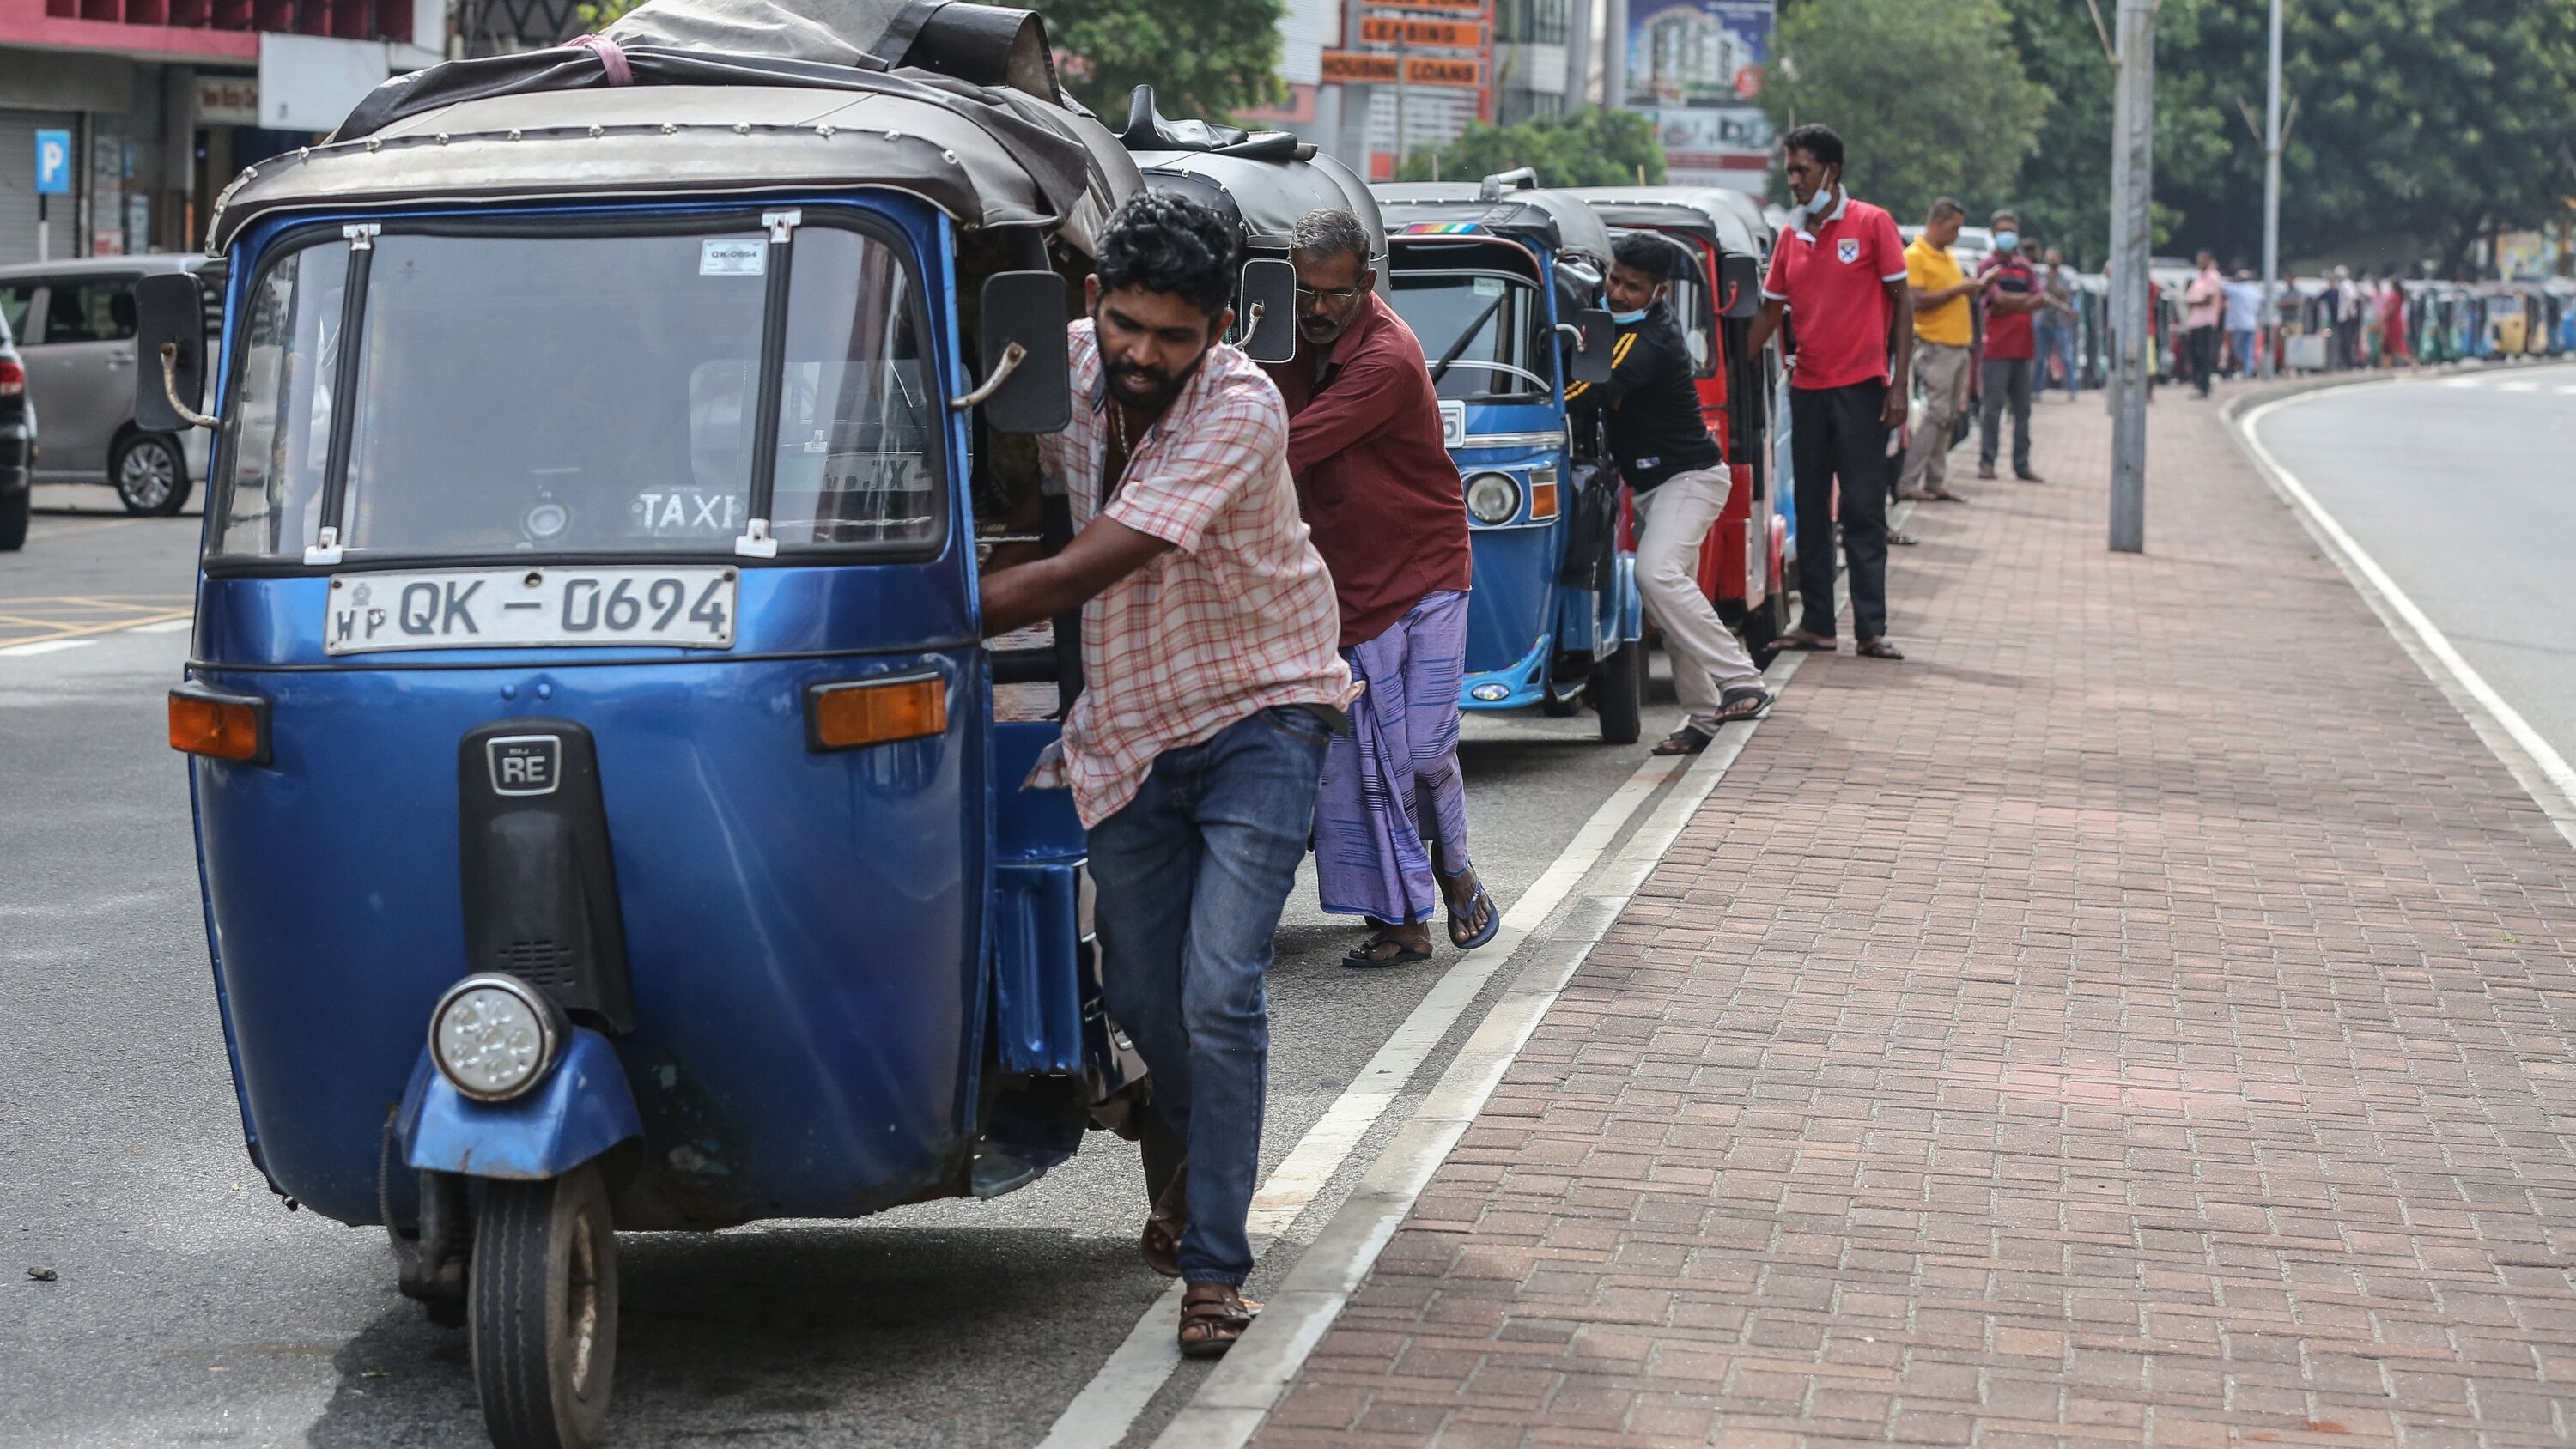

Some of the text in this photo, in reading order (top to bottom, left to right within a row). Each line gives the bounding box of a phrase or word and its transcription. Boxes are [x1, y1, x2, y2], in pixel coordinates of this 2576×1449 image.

[1363, 21, 1456, 42] LEASING
[1322, 57, 1475, 83] HOUSIN LOANS
[43, 141, 64, 184] P
[640, 494, 736, 529] TAXI
[502, 756, 546, 783] RE
